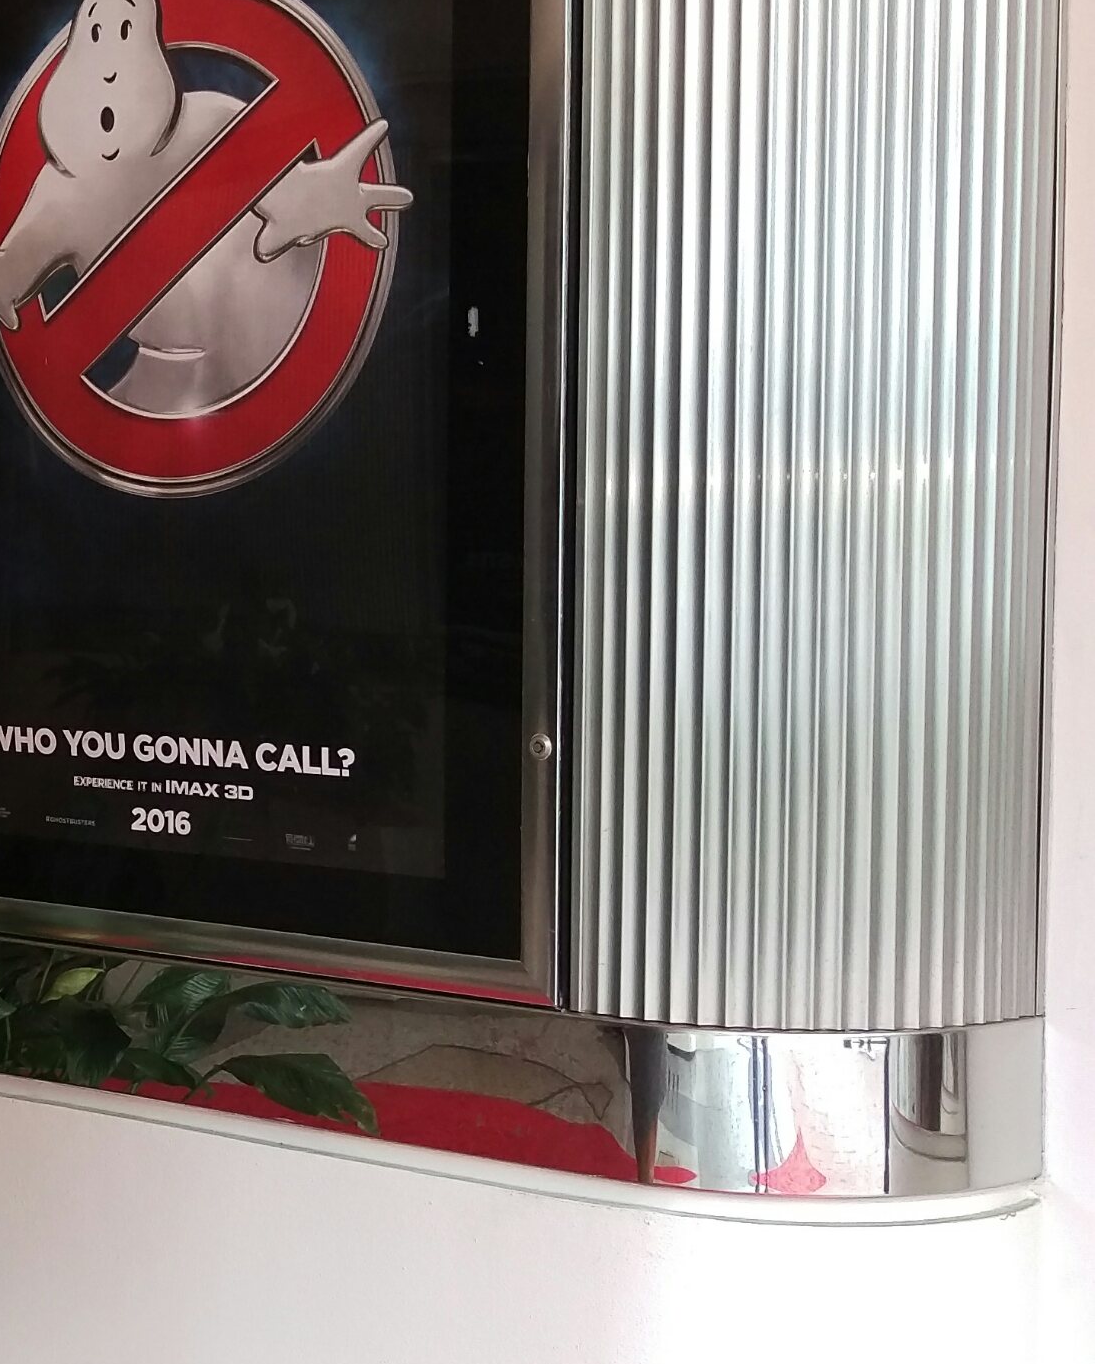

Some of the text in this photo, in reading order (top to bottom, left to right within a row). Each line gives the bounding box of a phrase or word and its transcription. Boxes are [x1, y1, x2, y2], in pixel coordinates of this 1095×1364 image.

[63, 729, 126, 760] YOU
[133, 733, 249, 770] GONNA
[255, 742, 356, 777] CALL?
[73, 775, 254, 801] EXPERIENCE IT IN IMAX 3D
[130, 806, 192, 836] 2016
